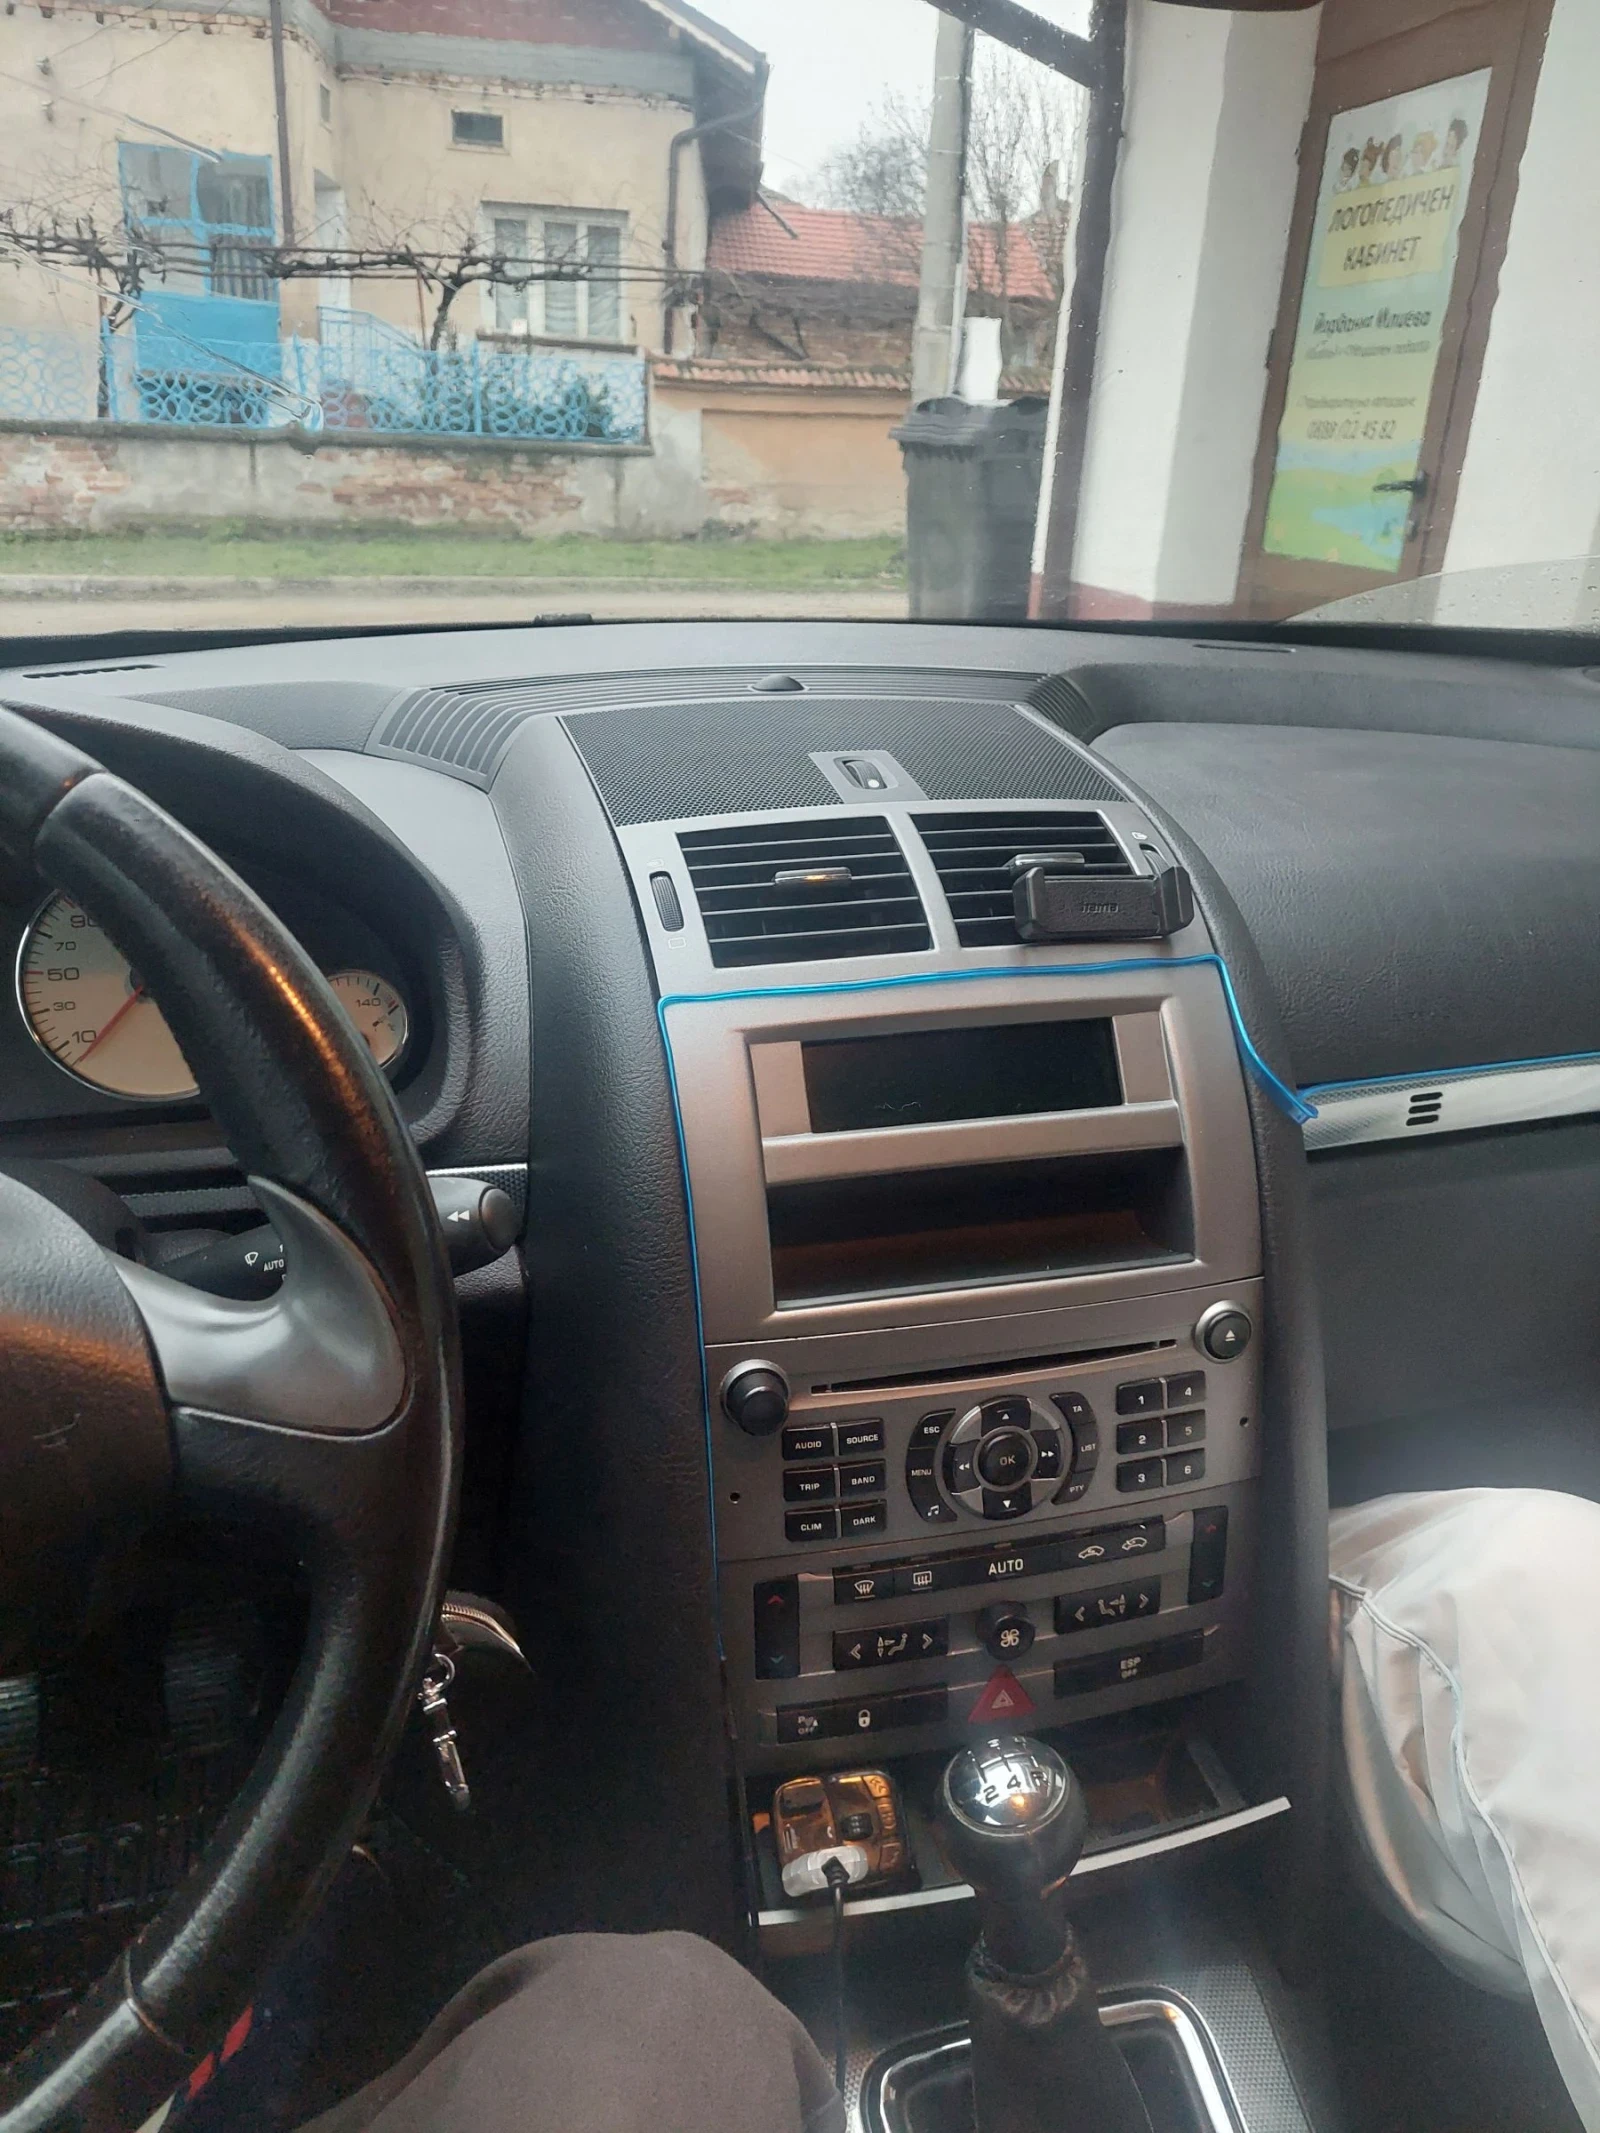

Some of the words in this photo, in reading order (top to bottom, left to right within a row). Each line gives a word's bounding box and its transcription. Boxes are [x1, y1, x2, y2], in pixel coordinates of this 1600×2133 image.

[1328, 184, 1455, 233] ЛОГОПЕДИЧЕН
[1343, 235, 1422, 271] КАБИНЕТ
[54, 941, 76, 951] 70
[47, 967, 80, 981] 50
[53, 1001, 76, 1011] 30
[355, 998, 381, 1007] 140
[72, 1029, 97, 1043] 10
[263, 1258, 285, 1272] AUTO
[1184, 1387, 1192, 1396] 4
[1138, 1395, 1145, 1405] 1
[1072, 1405, 1083, 1413] TA
[923, 1425, 941, 1434] ESC
[1185, 1426, 1193, 1436] 5
[846, 1433, 879, 1445] SOURCE
[1138, 1435, 1146, 1445] 2
[795, 1440, 822, 1450] AUDIO
[1080, 1443, 1097, 1453] LIST
[999, 1455, 1016, 1467] OK
[911, 1468, 932, 1477] MENU
[1184, 1465, 1192, 1475] 6
[851, 1475, 876, 1486] BAND
[1137, 1473, 1146, 1483] 3
[799, 1482, 821, 1492] TRIP
[1069, 1484, 1085, 1493] PTY
[853, 1515, 876, 1527] DARK
[800, 1522, 822, 1532] CLIM
[988, 1558, 1024, 1576] AUTO
[1120, 1656, 1141, 1670] ESP
[1007, 1774, 1021, 1789] 4
[983, 1785, 1000, 1804] 2
